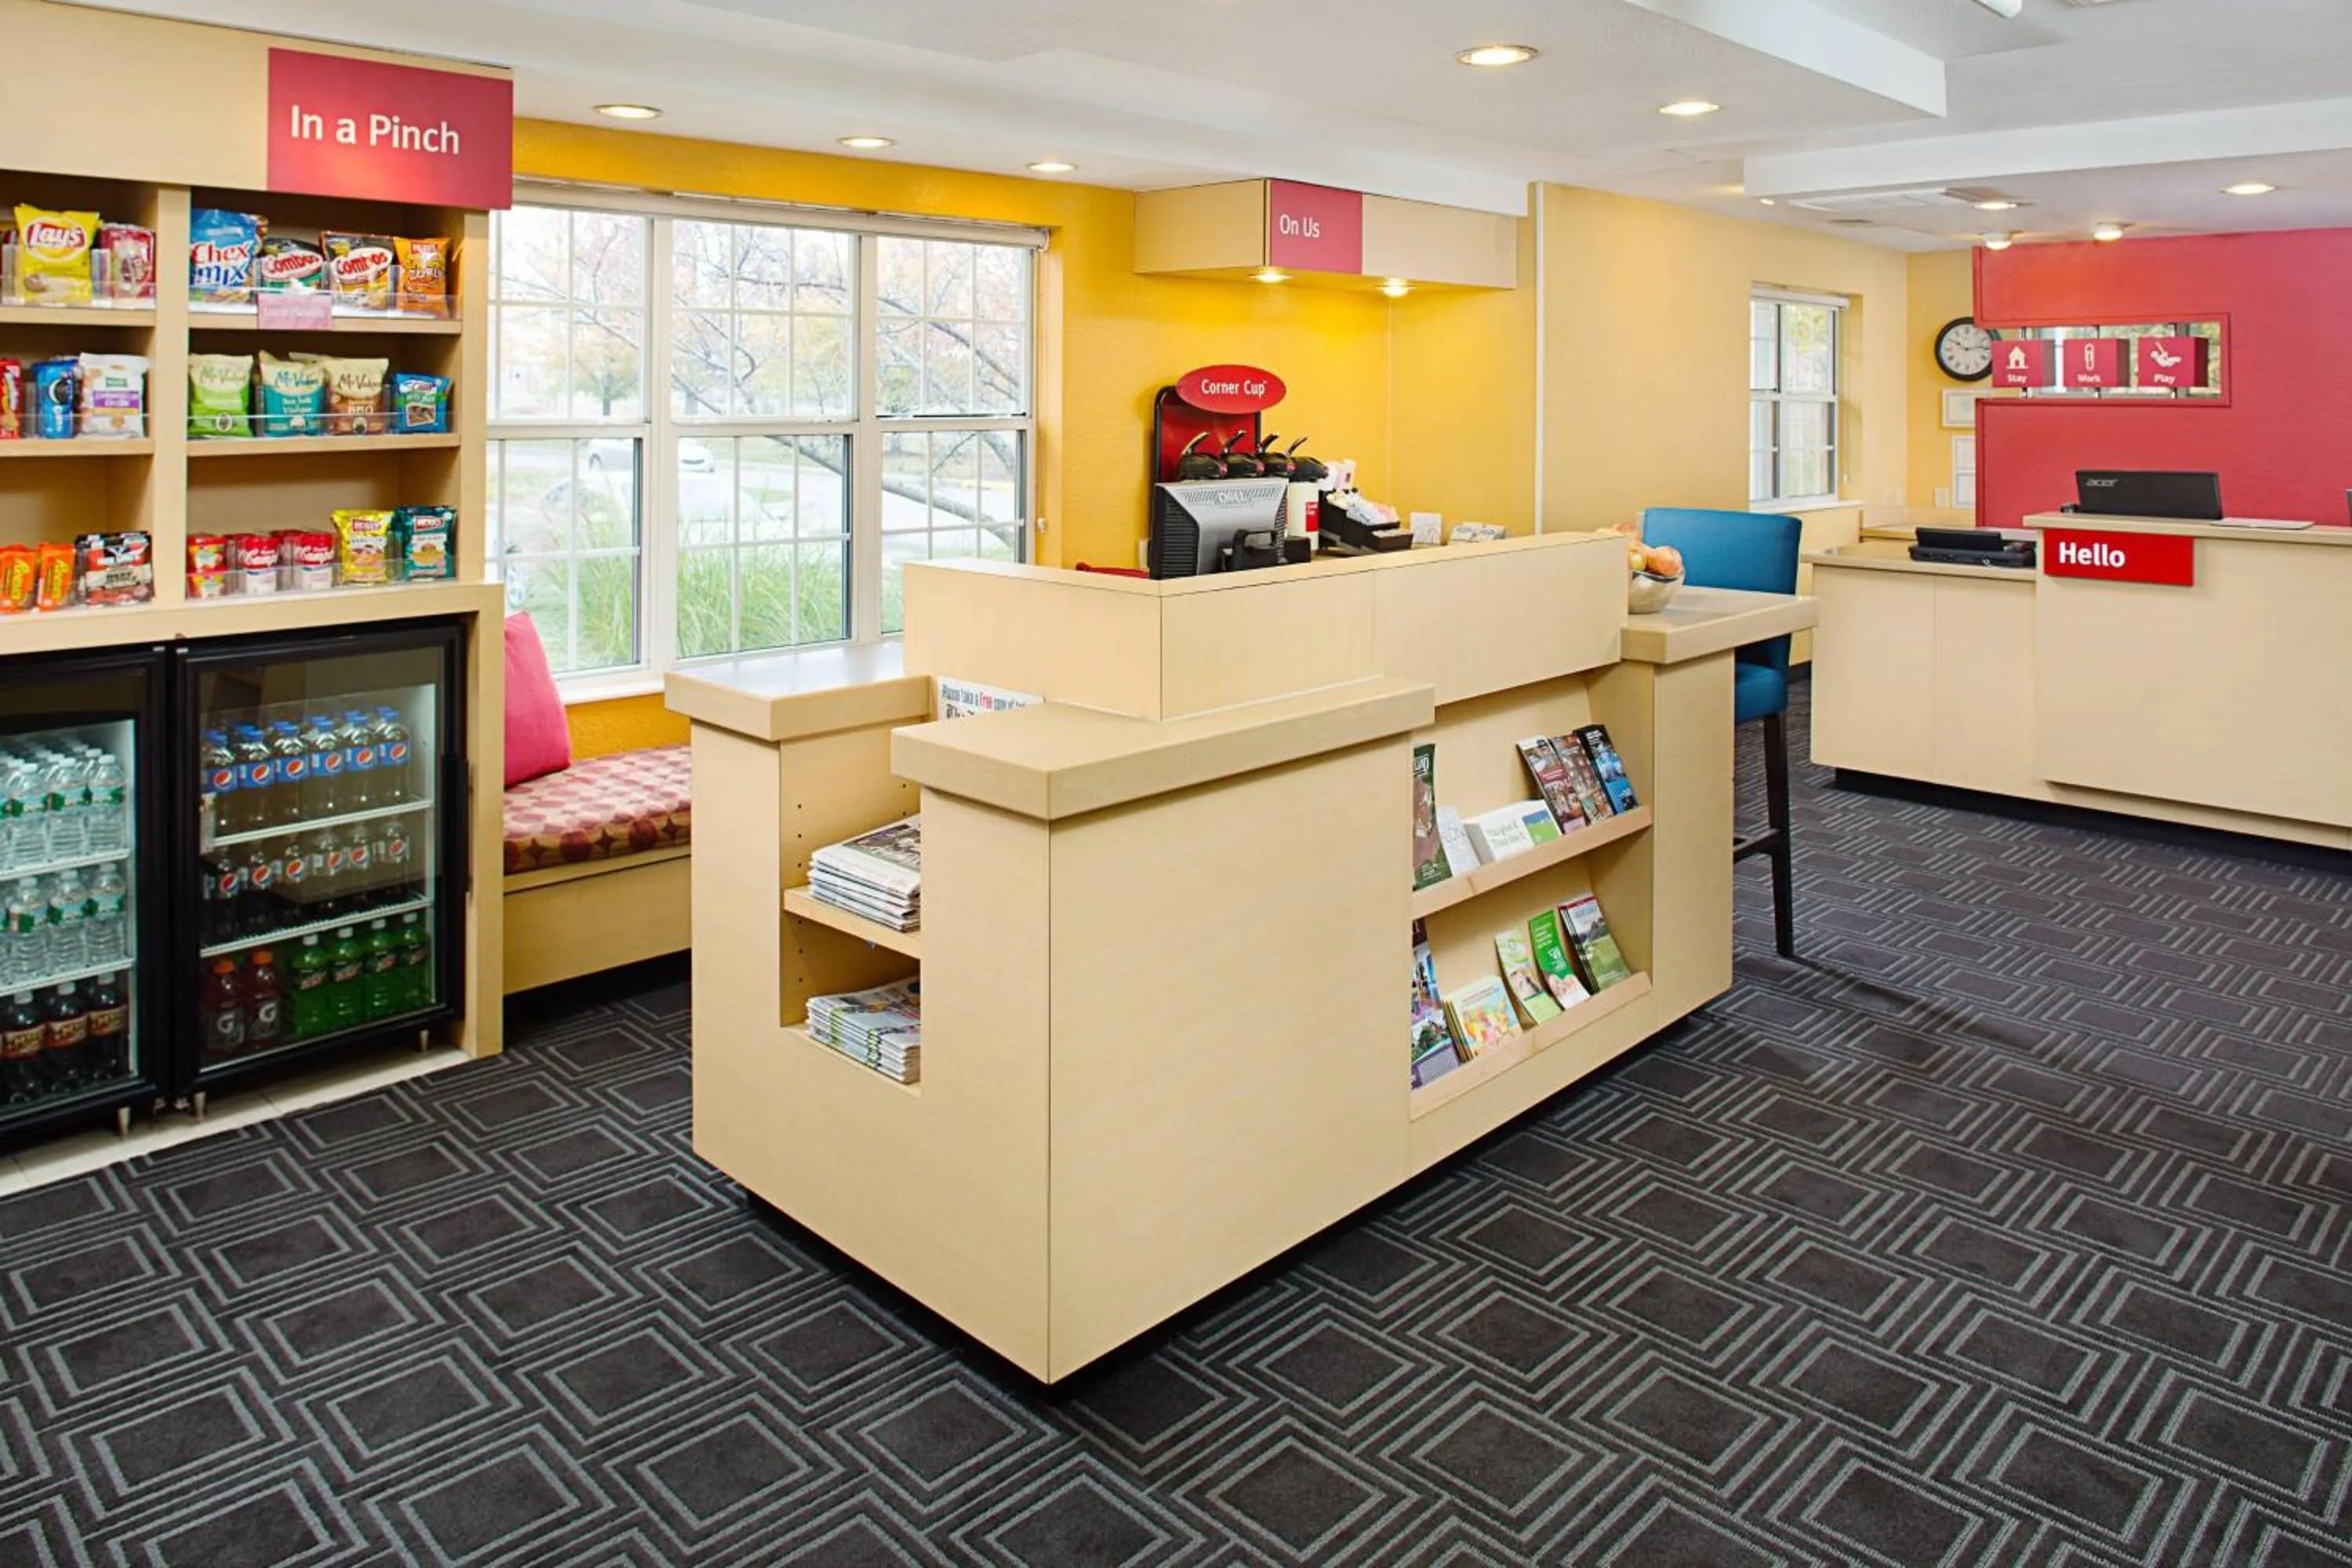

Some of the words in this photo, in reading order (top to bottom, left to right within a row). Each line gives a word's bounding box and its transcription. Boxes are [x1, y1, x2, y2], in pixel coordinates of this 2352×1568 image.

[291, 104, 323, 140] In
[336, 118, 357, 144] a
[369, 114, 459, 154] Pinch
[1279, 213, 1299, 235] On
[1303, 216, 1320, 238] Us
[2006, 373, 2027, 384] Stay
[2077, 373, 2101, 383] Work
[2154, 373, 2176, 384] Play
[1201, 379, 1240, 395] Corner
[2085, 477, 2118, 487] acer
[2058, 541, 2126, 568] Hello
